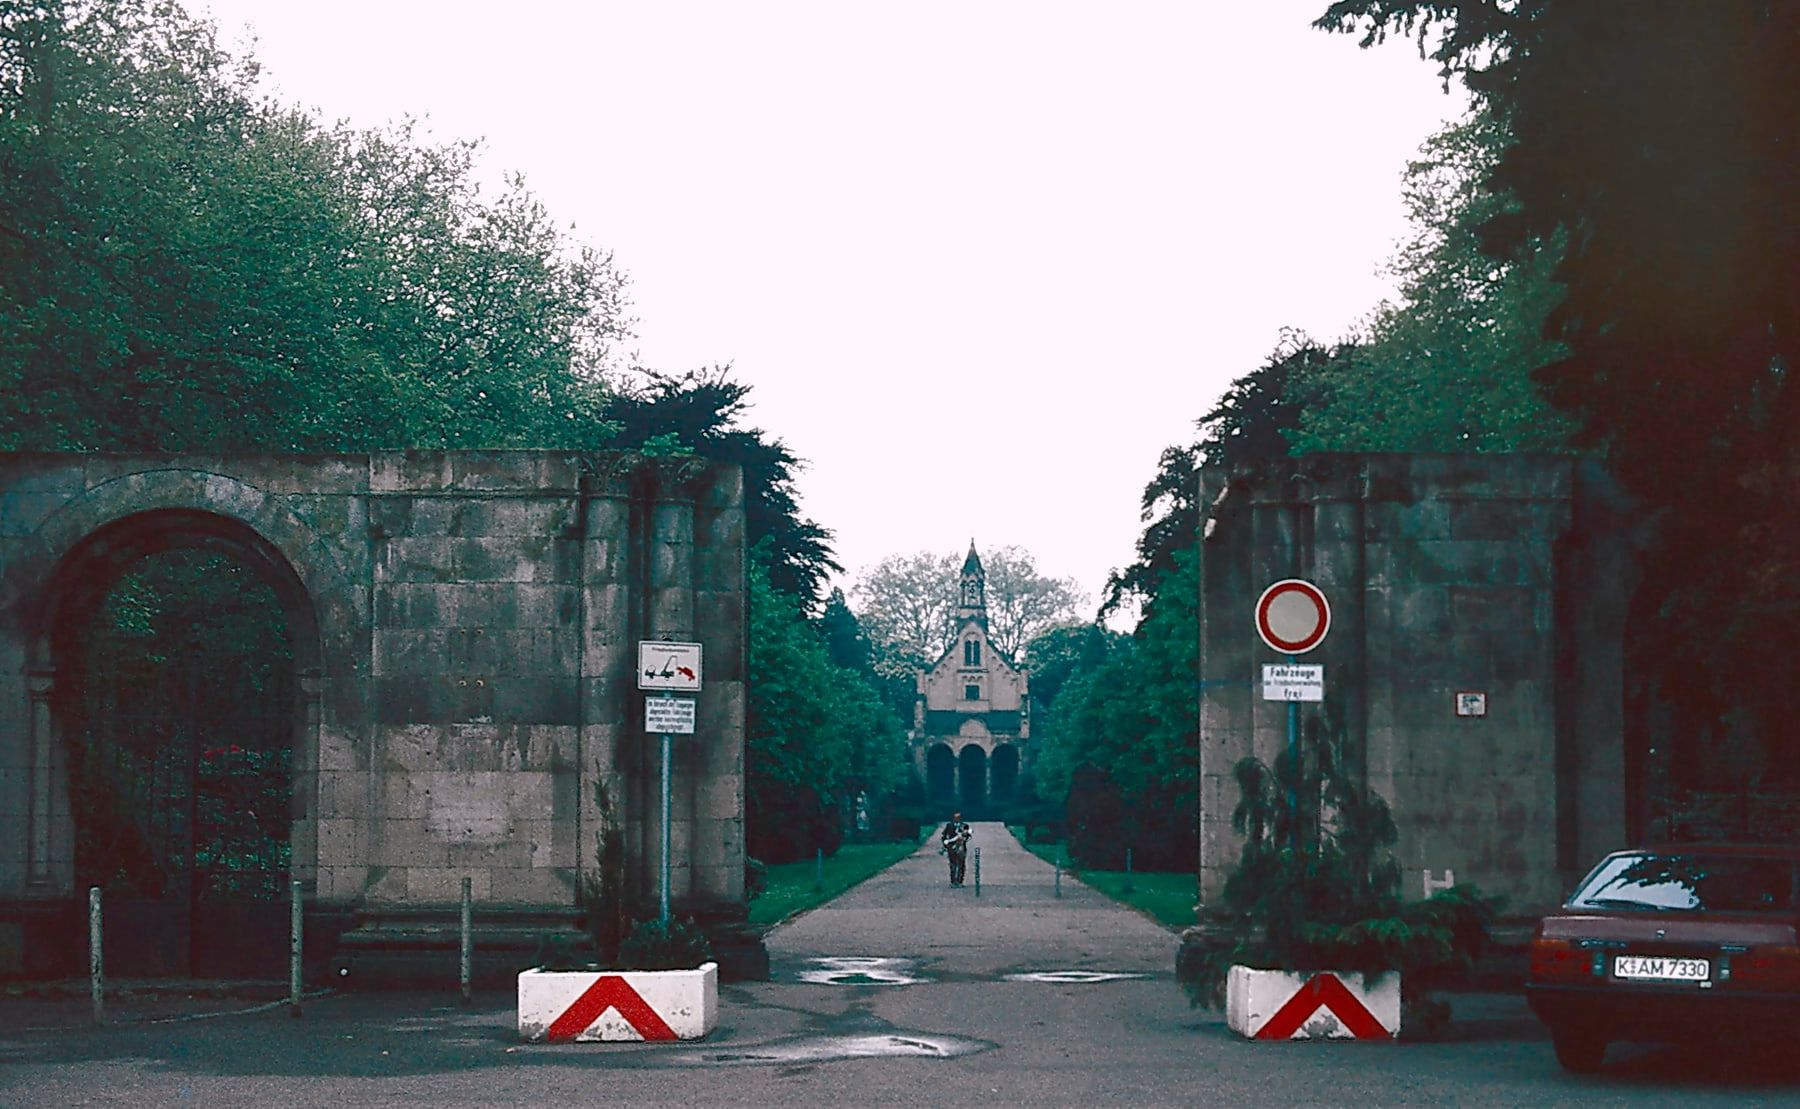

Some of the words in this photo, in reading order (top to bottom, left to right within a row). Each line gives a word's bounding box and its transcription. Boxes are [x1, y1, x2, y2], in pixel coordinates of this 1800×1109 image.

[1270, 667, 1315, 680] Fahrzeuge
[1284, 688, 1303, 698] frei
[1618, 959, 1629, 974] K
[1638, 960, 1664, 975] AM
[1668, 961, 1706, 977] 7330
